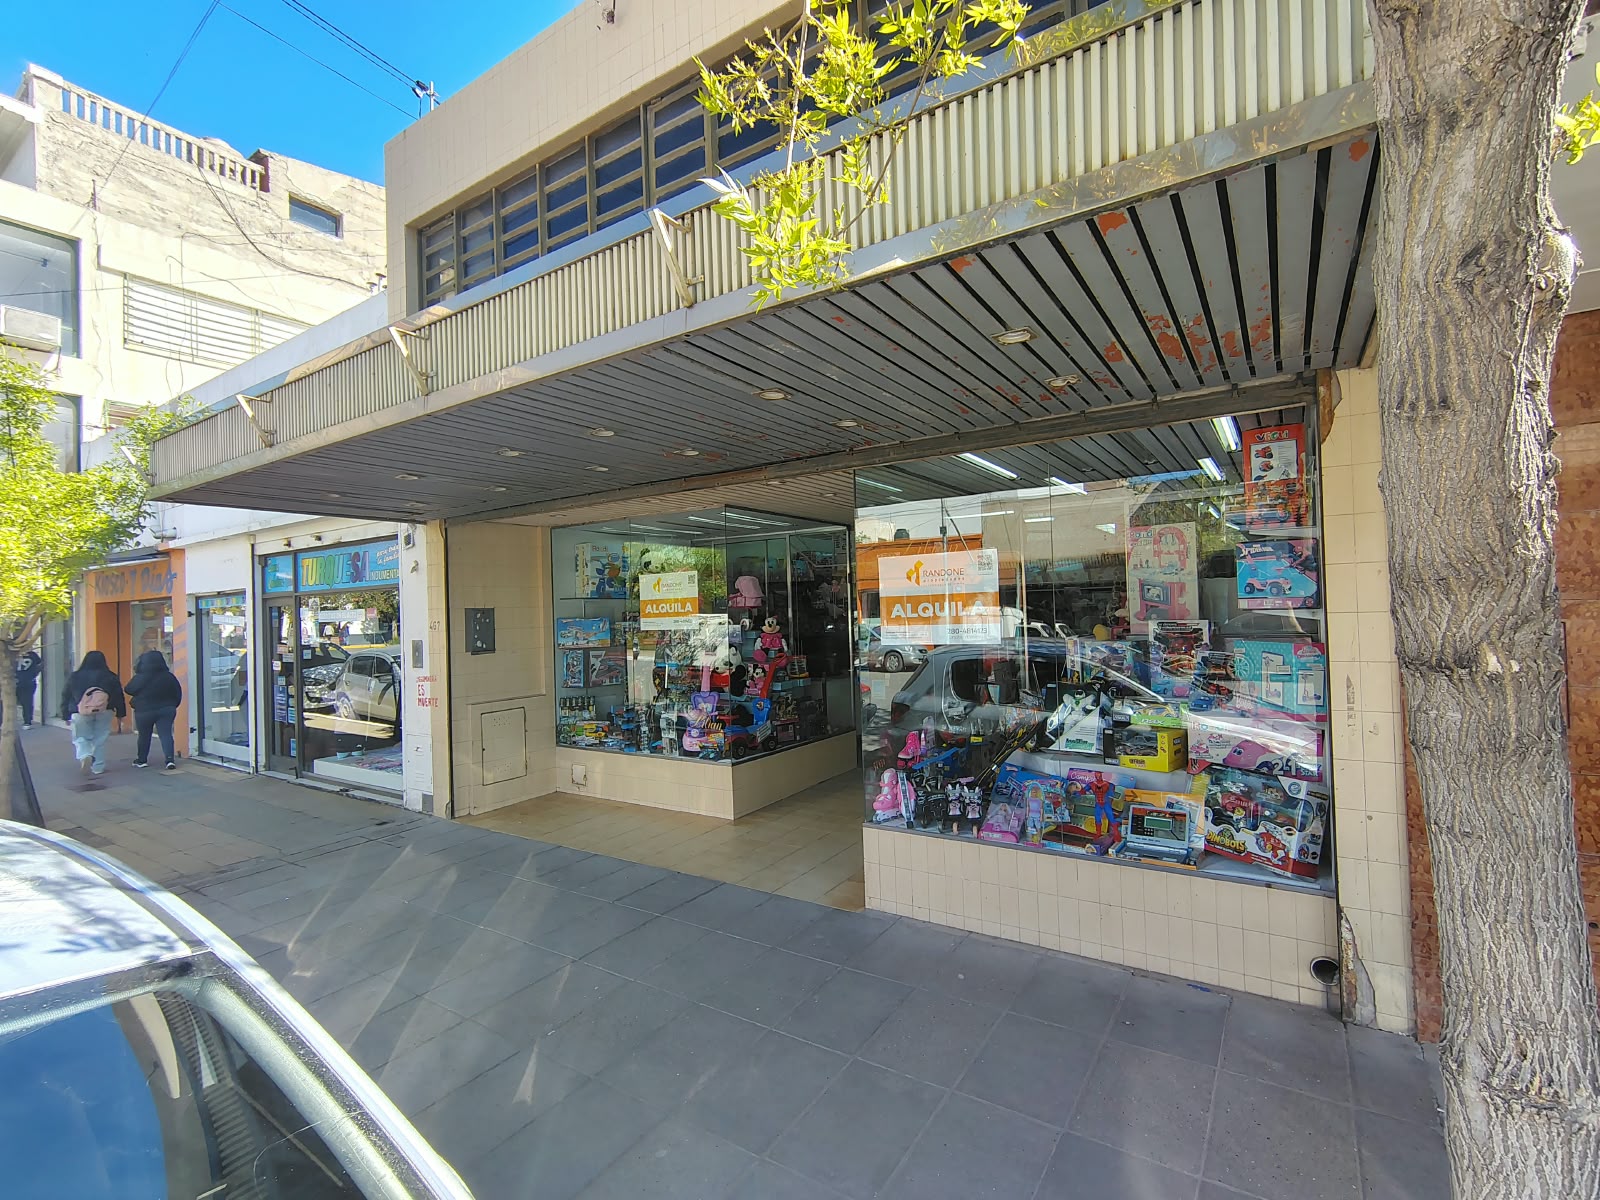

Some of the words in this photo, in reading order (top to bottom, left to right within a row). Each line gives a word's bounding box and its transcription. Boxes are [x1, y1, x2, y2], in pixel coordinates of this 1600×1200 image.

[302, 551, 369, 588] TURQUESA
[923, 567, 965, 578] RANDONE
[645, 602, 693, 614] ALQUILA
[891, 600, 988, 619] ALQUILA
[1205, 829, 1247, 852] DINOBOTS
